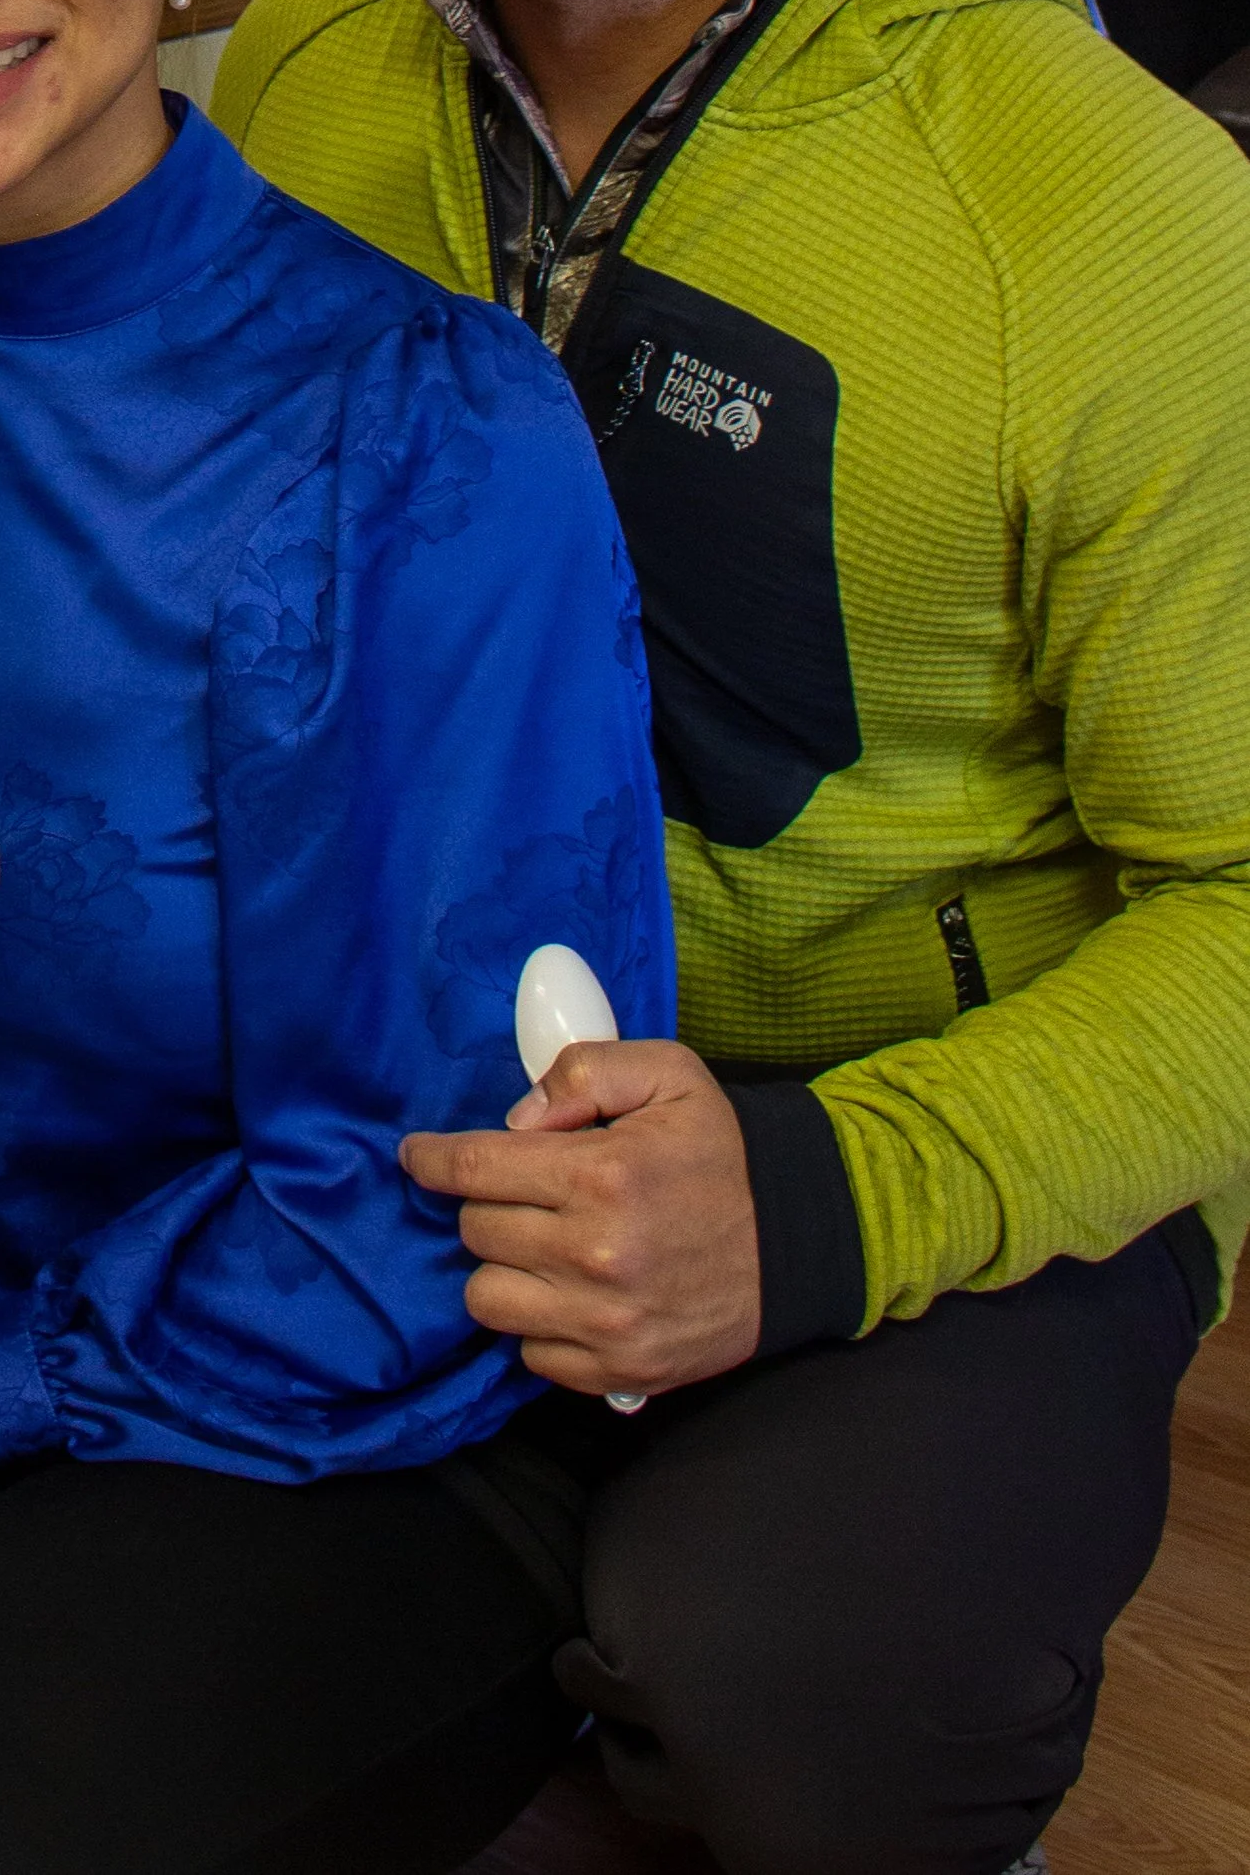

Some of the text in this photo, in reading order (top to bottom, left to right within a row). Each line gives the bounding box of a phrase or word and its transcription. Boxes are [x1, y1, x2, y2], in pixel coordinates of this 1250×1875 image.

[663, 368, 721, 410] HARD
[671, 351, 773, 408] MOUNTAIN
[655, 389, 713, 437] WEAR
